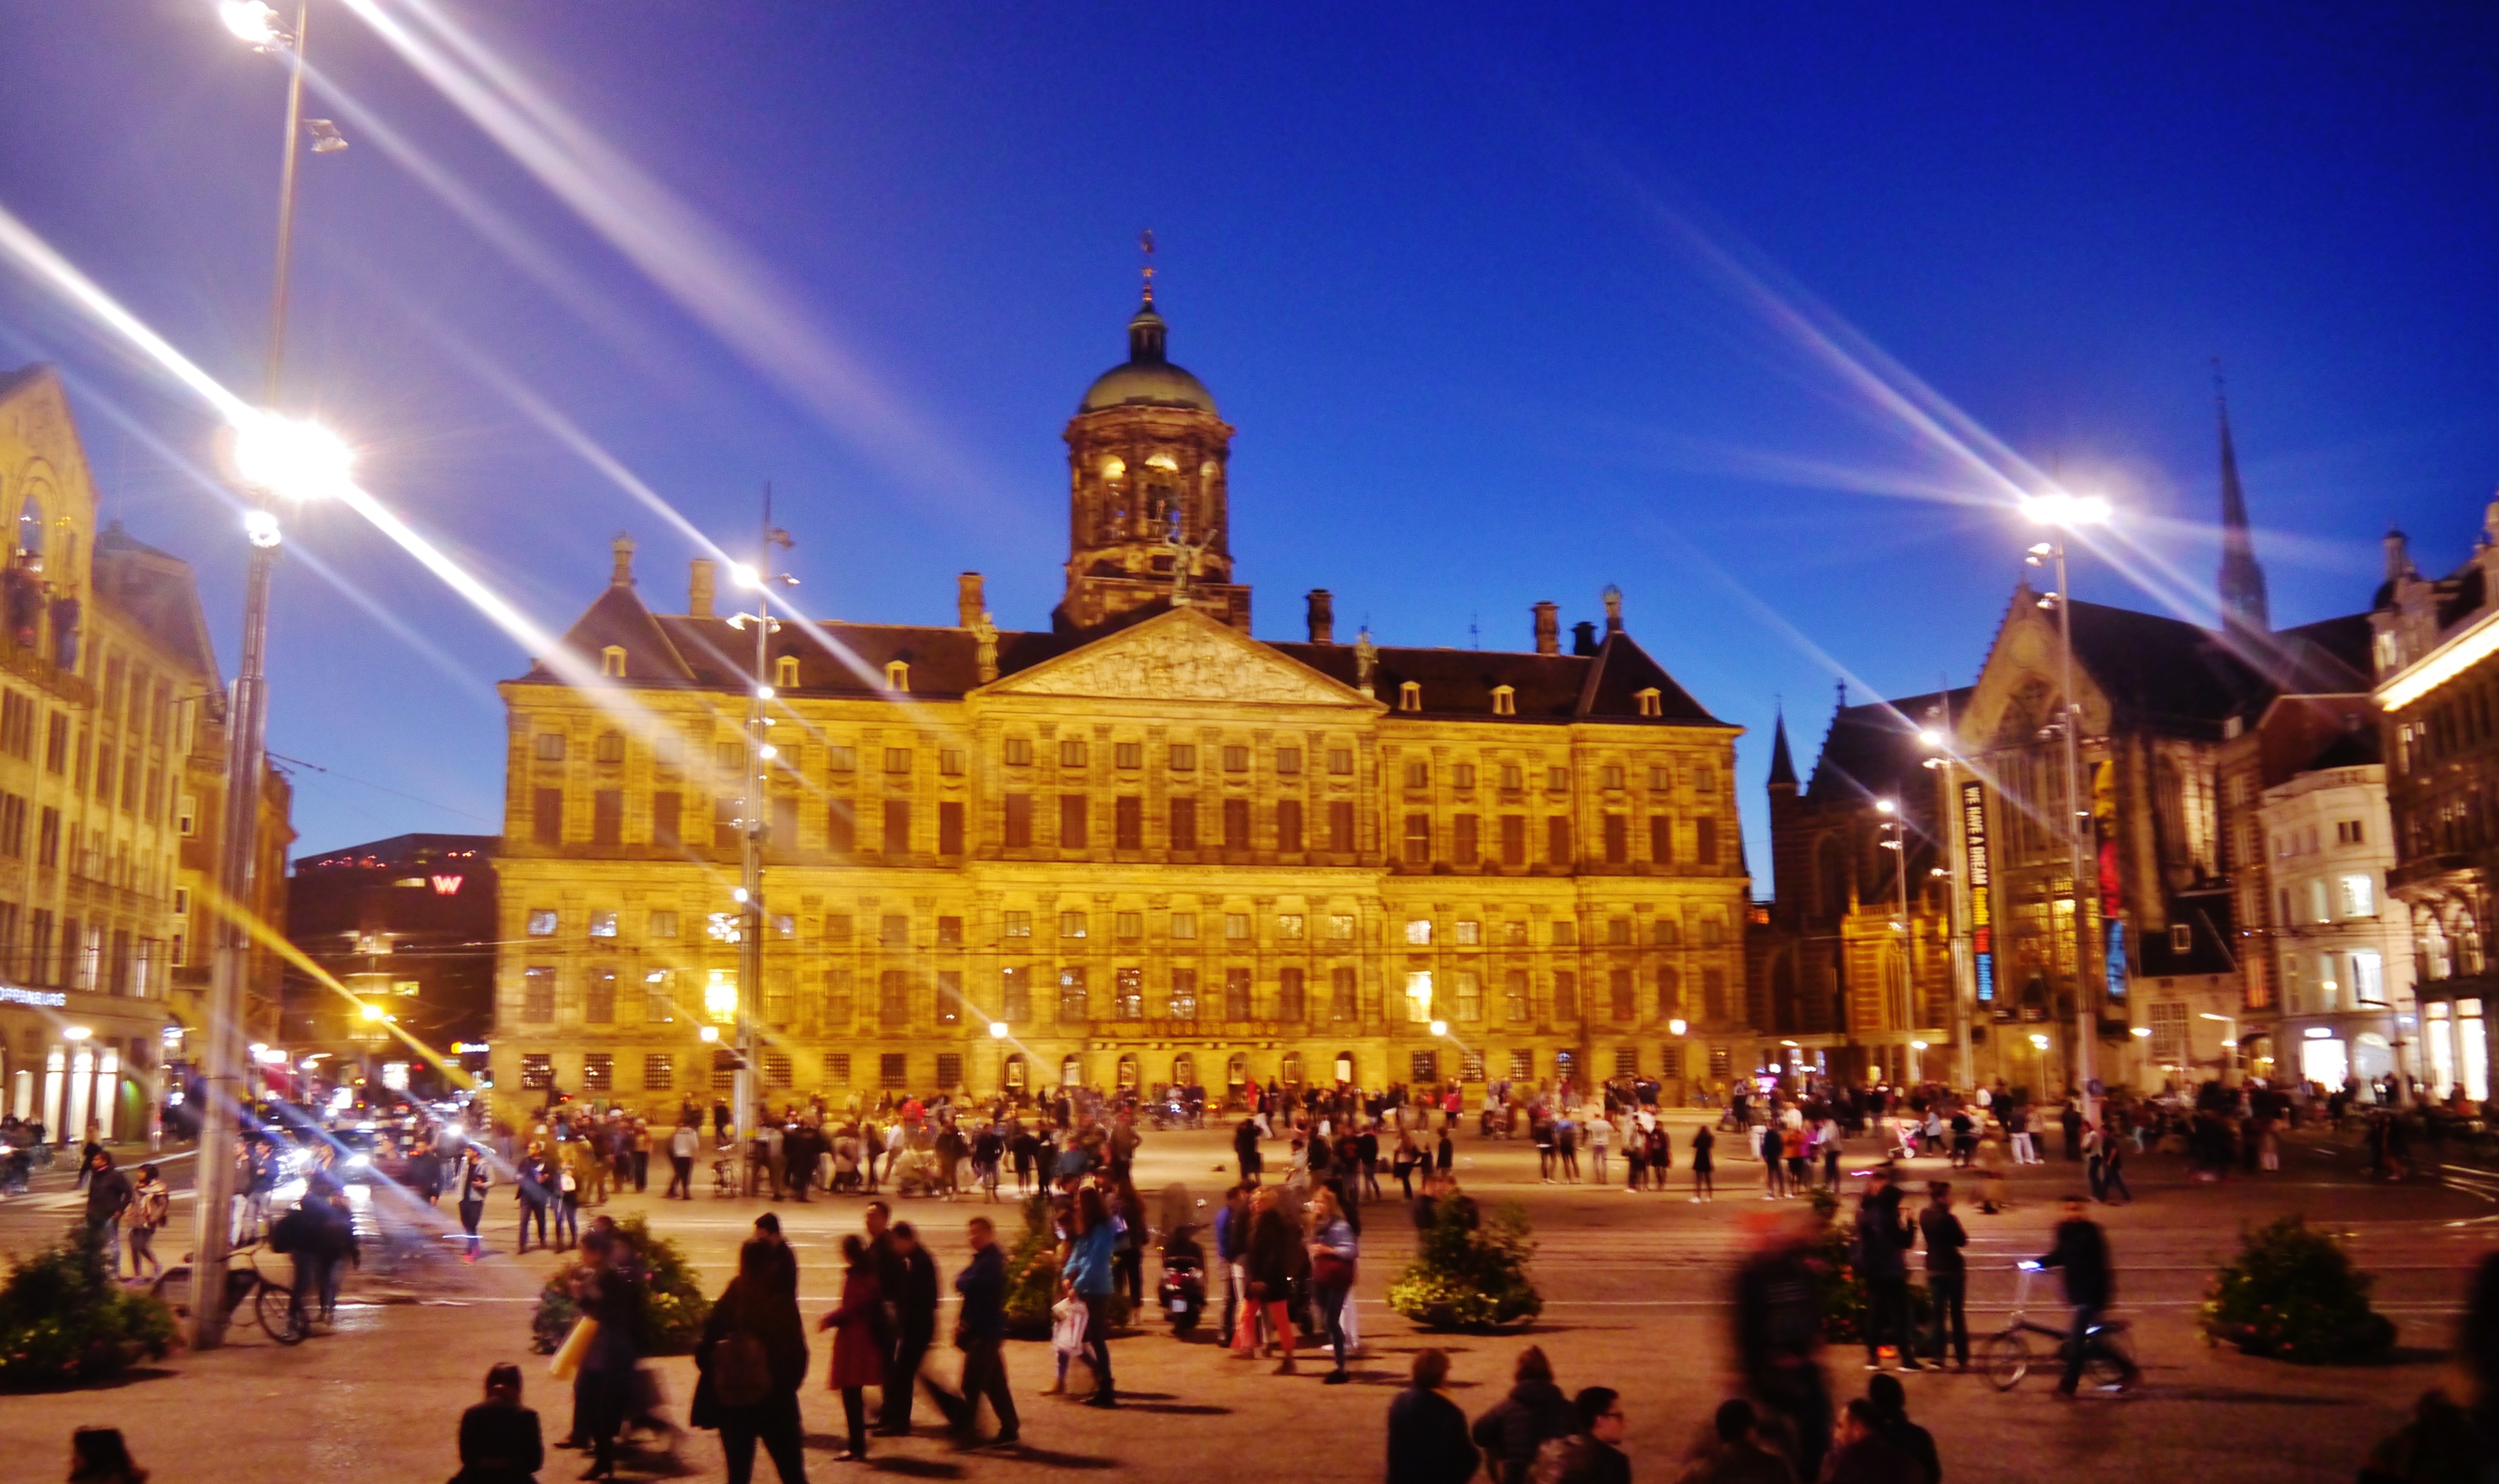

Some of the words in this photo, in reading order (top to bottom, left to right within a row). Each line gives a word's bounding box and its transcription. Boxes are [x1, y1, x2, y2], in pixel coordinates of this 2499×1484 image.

[1965, 787, 1980, 804] WE
[1966, 806, 1984, 834] HAVE
[1969, 846, 1988, 884] DREAM
[431, 875, 464, 895] W
[1976, 954, 1993, 1001] Mandela
